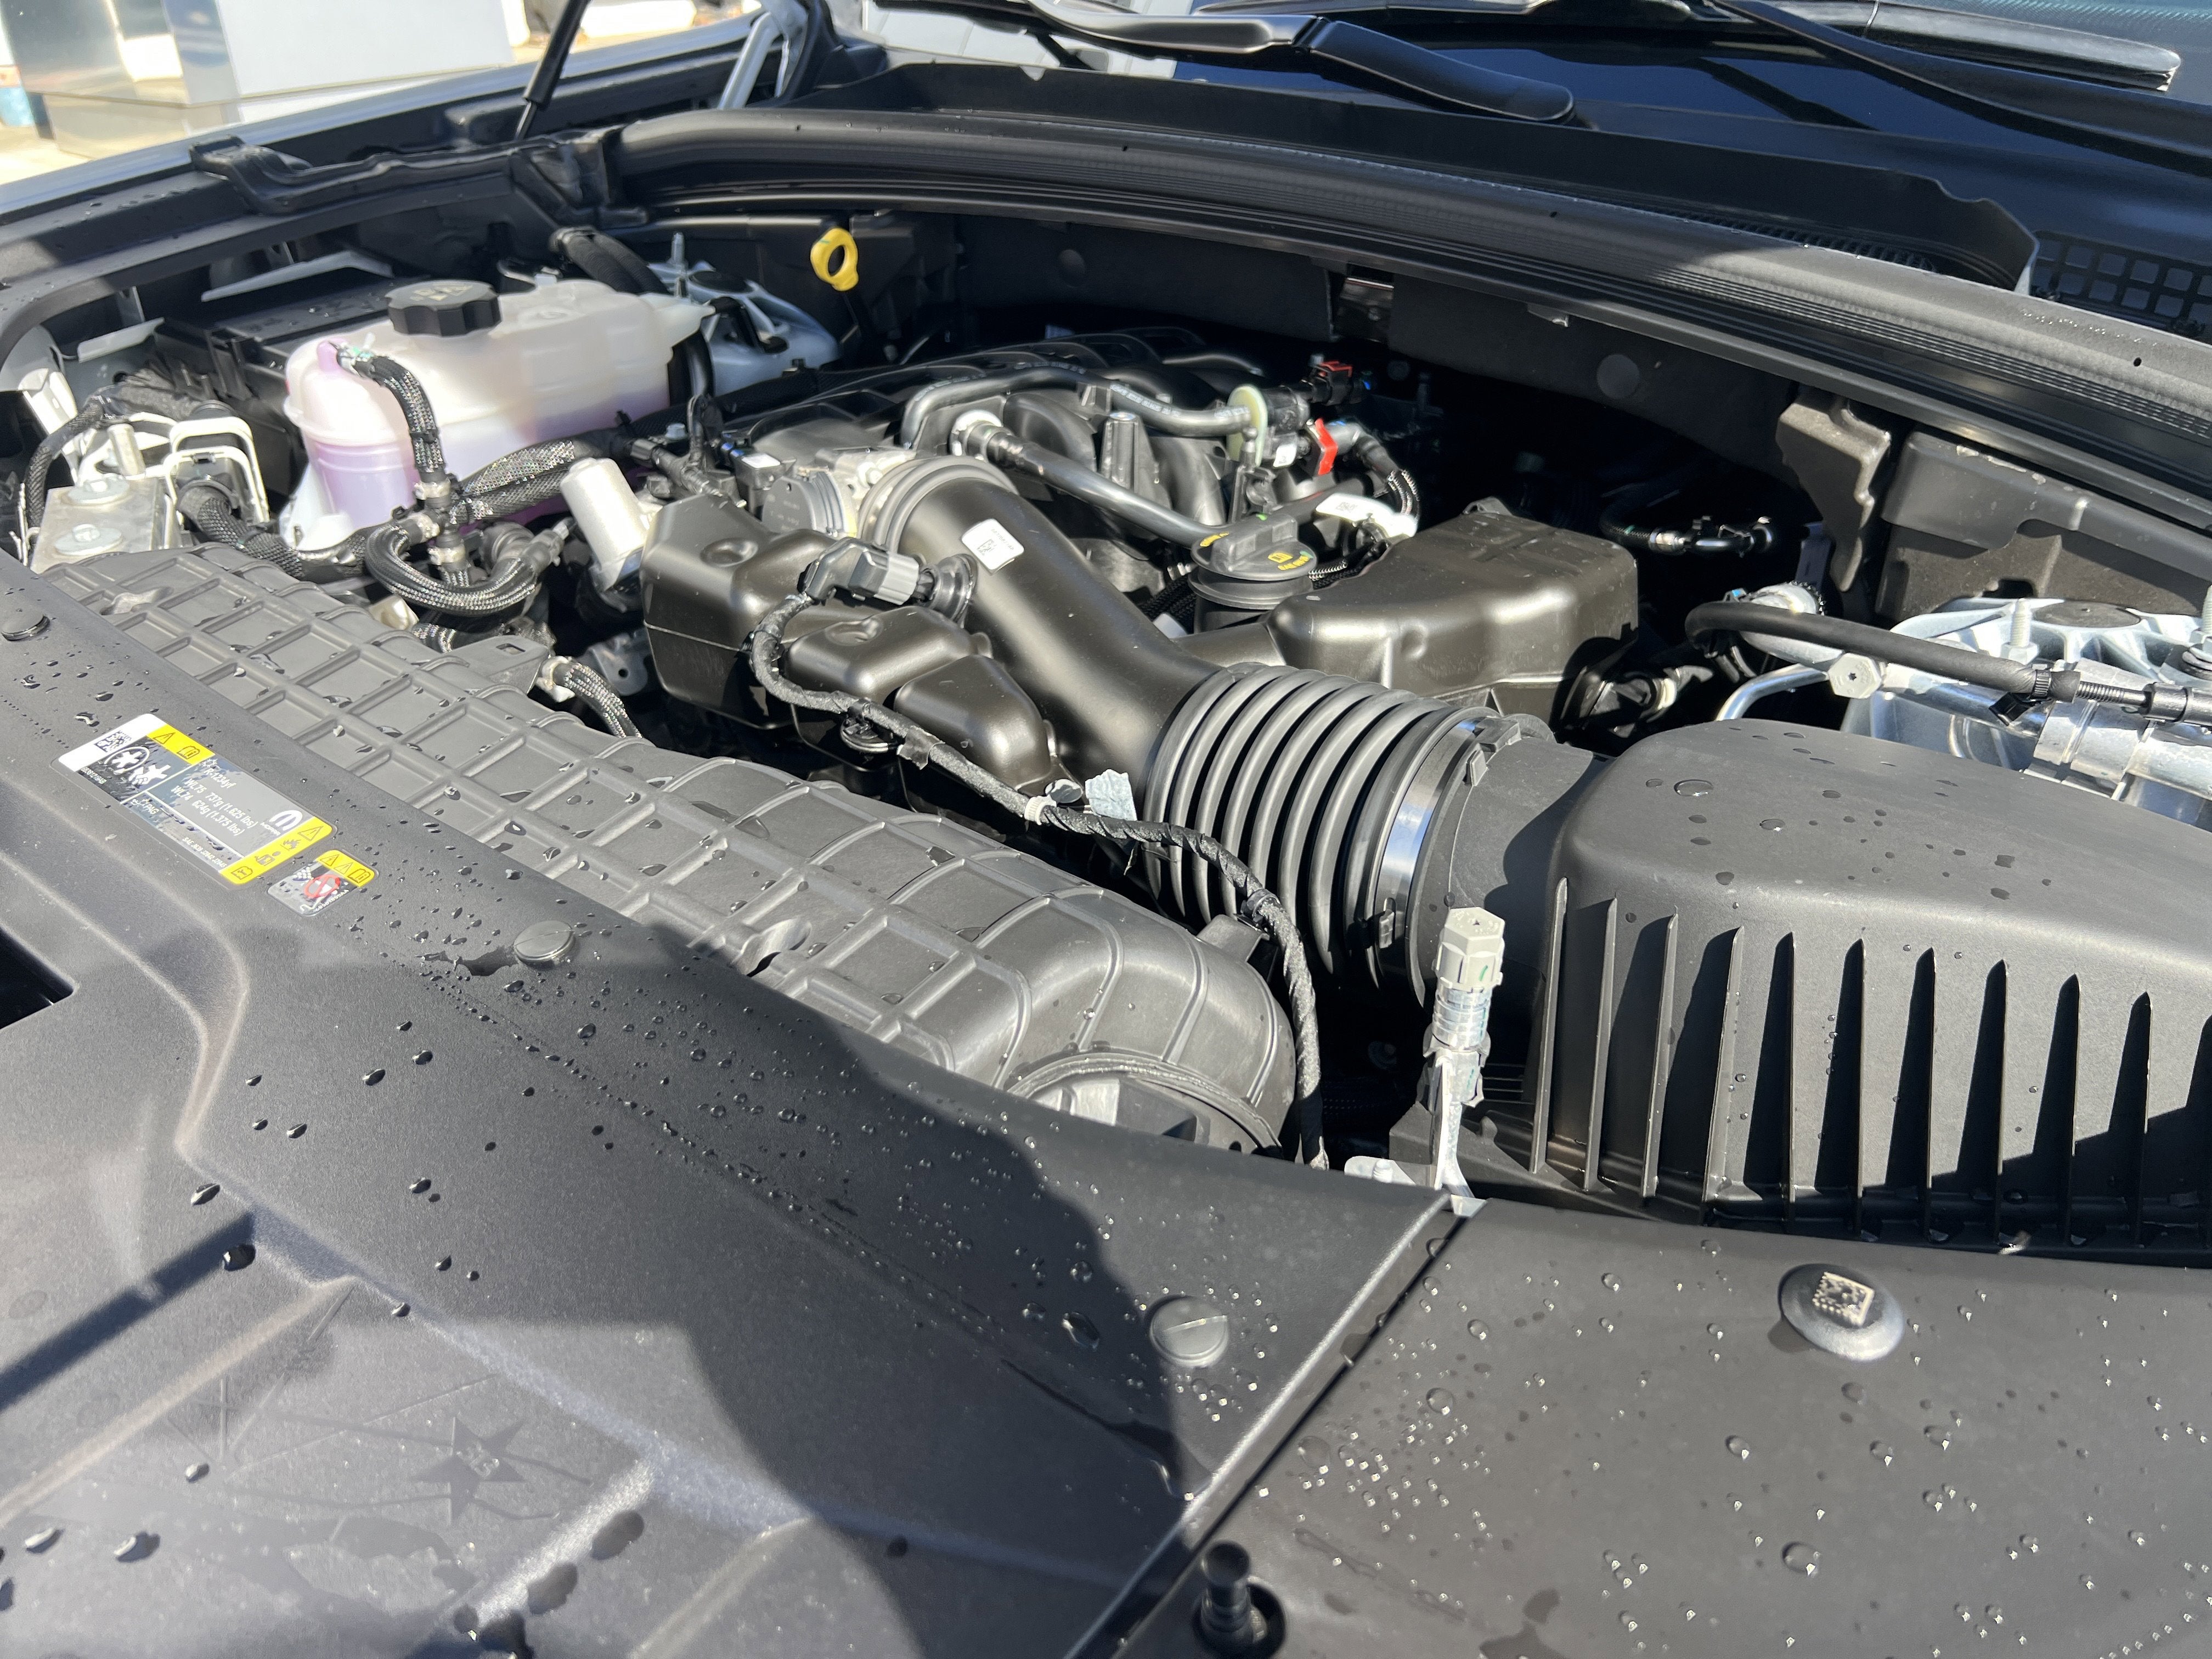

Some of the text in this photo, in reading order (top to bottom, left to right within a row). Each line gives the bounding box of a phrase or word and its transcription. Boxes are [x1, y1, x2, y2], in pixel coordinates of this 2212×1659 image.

[204, 767, 238, 789] R-1234yf
[144, 803, 160, 815] PAG
[171, 786, 246, 837] WL74 624g (1.375 lbs)
[184, 778, 260, 829] WL75 737g (1.625 lbs)
[183, 837, 195, 845] SAE
